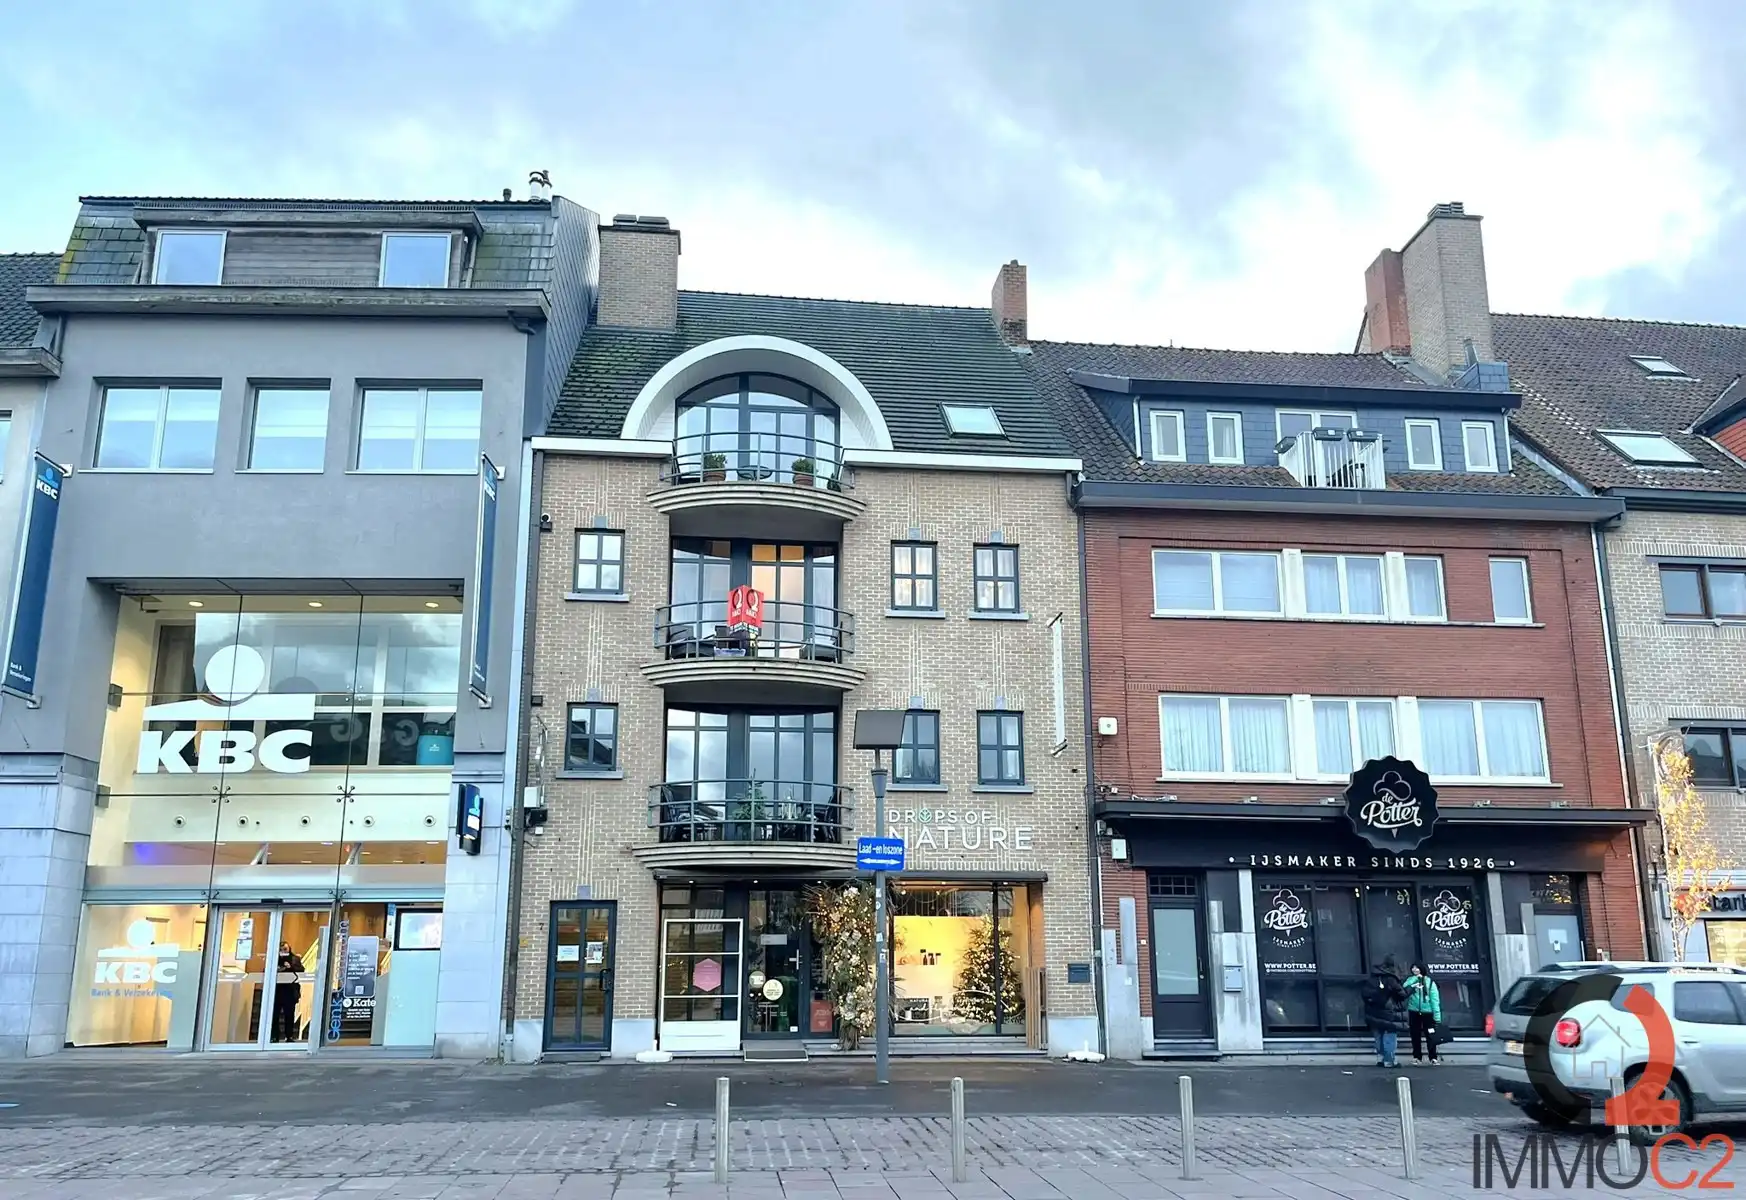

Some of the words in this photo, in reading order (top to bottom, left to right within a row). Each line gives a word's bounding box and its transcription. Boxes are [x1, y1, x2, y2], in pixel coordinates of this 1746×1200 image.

[36, 480, 58, 500] KBC
[136, 729, 313, 774] KBC
[1381, 792, 1393, 804] de
[964, 809, 993, 825] OF
[1360, 797, 1423, 829] Potter
[858, 842, 872, 854] Laad
[888, 825, 1033, 851] NATURE
[1249, 854, 1356, 867] IJSMAKER
[1371, 856, 1433, 869] SINDS
[1448, 857, 1496, 869] 1926
[1263, 907, 1308, 930] Potter
[1425, 908, 1469, 931] Potter
[94, 961, 178, 984] KBC
[353, 998, 377, 1008] Kate
